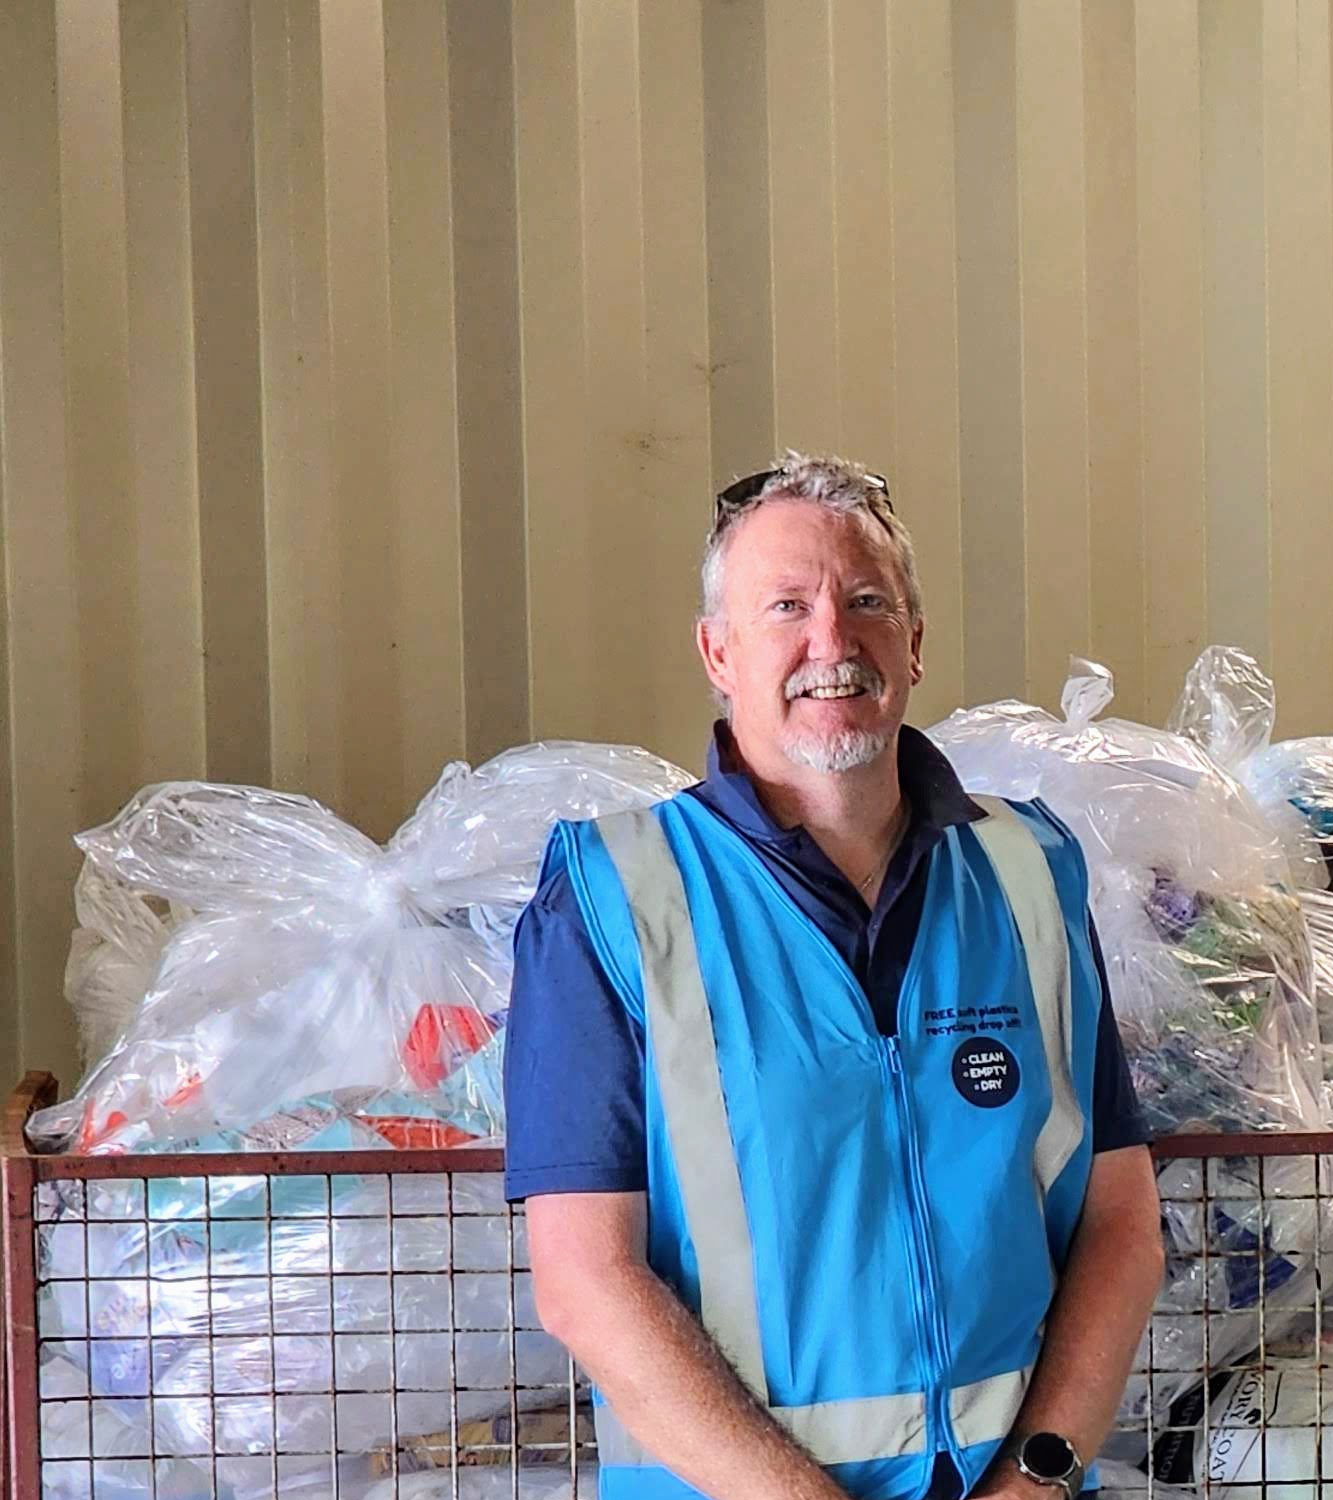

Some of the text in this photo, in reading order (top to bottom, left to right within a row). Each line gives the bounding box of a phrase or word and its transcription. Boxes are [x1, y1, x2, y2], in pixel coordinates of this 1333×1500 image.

[924, 1008, 955, 1021] FREE
[978, 1004, 1018, 1018] plastics
[926, 1022, 976, 1035] recycling
[978, 1019, 1004, 1031] drop
[968, 1052, 1004, 1064] CLEAN
[970, 1065, 1007, 1078] EMPTY
[981, 1079, 1002, 1091] DRY
